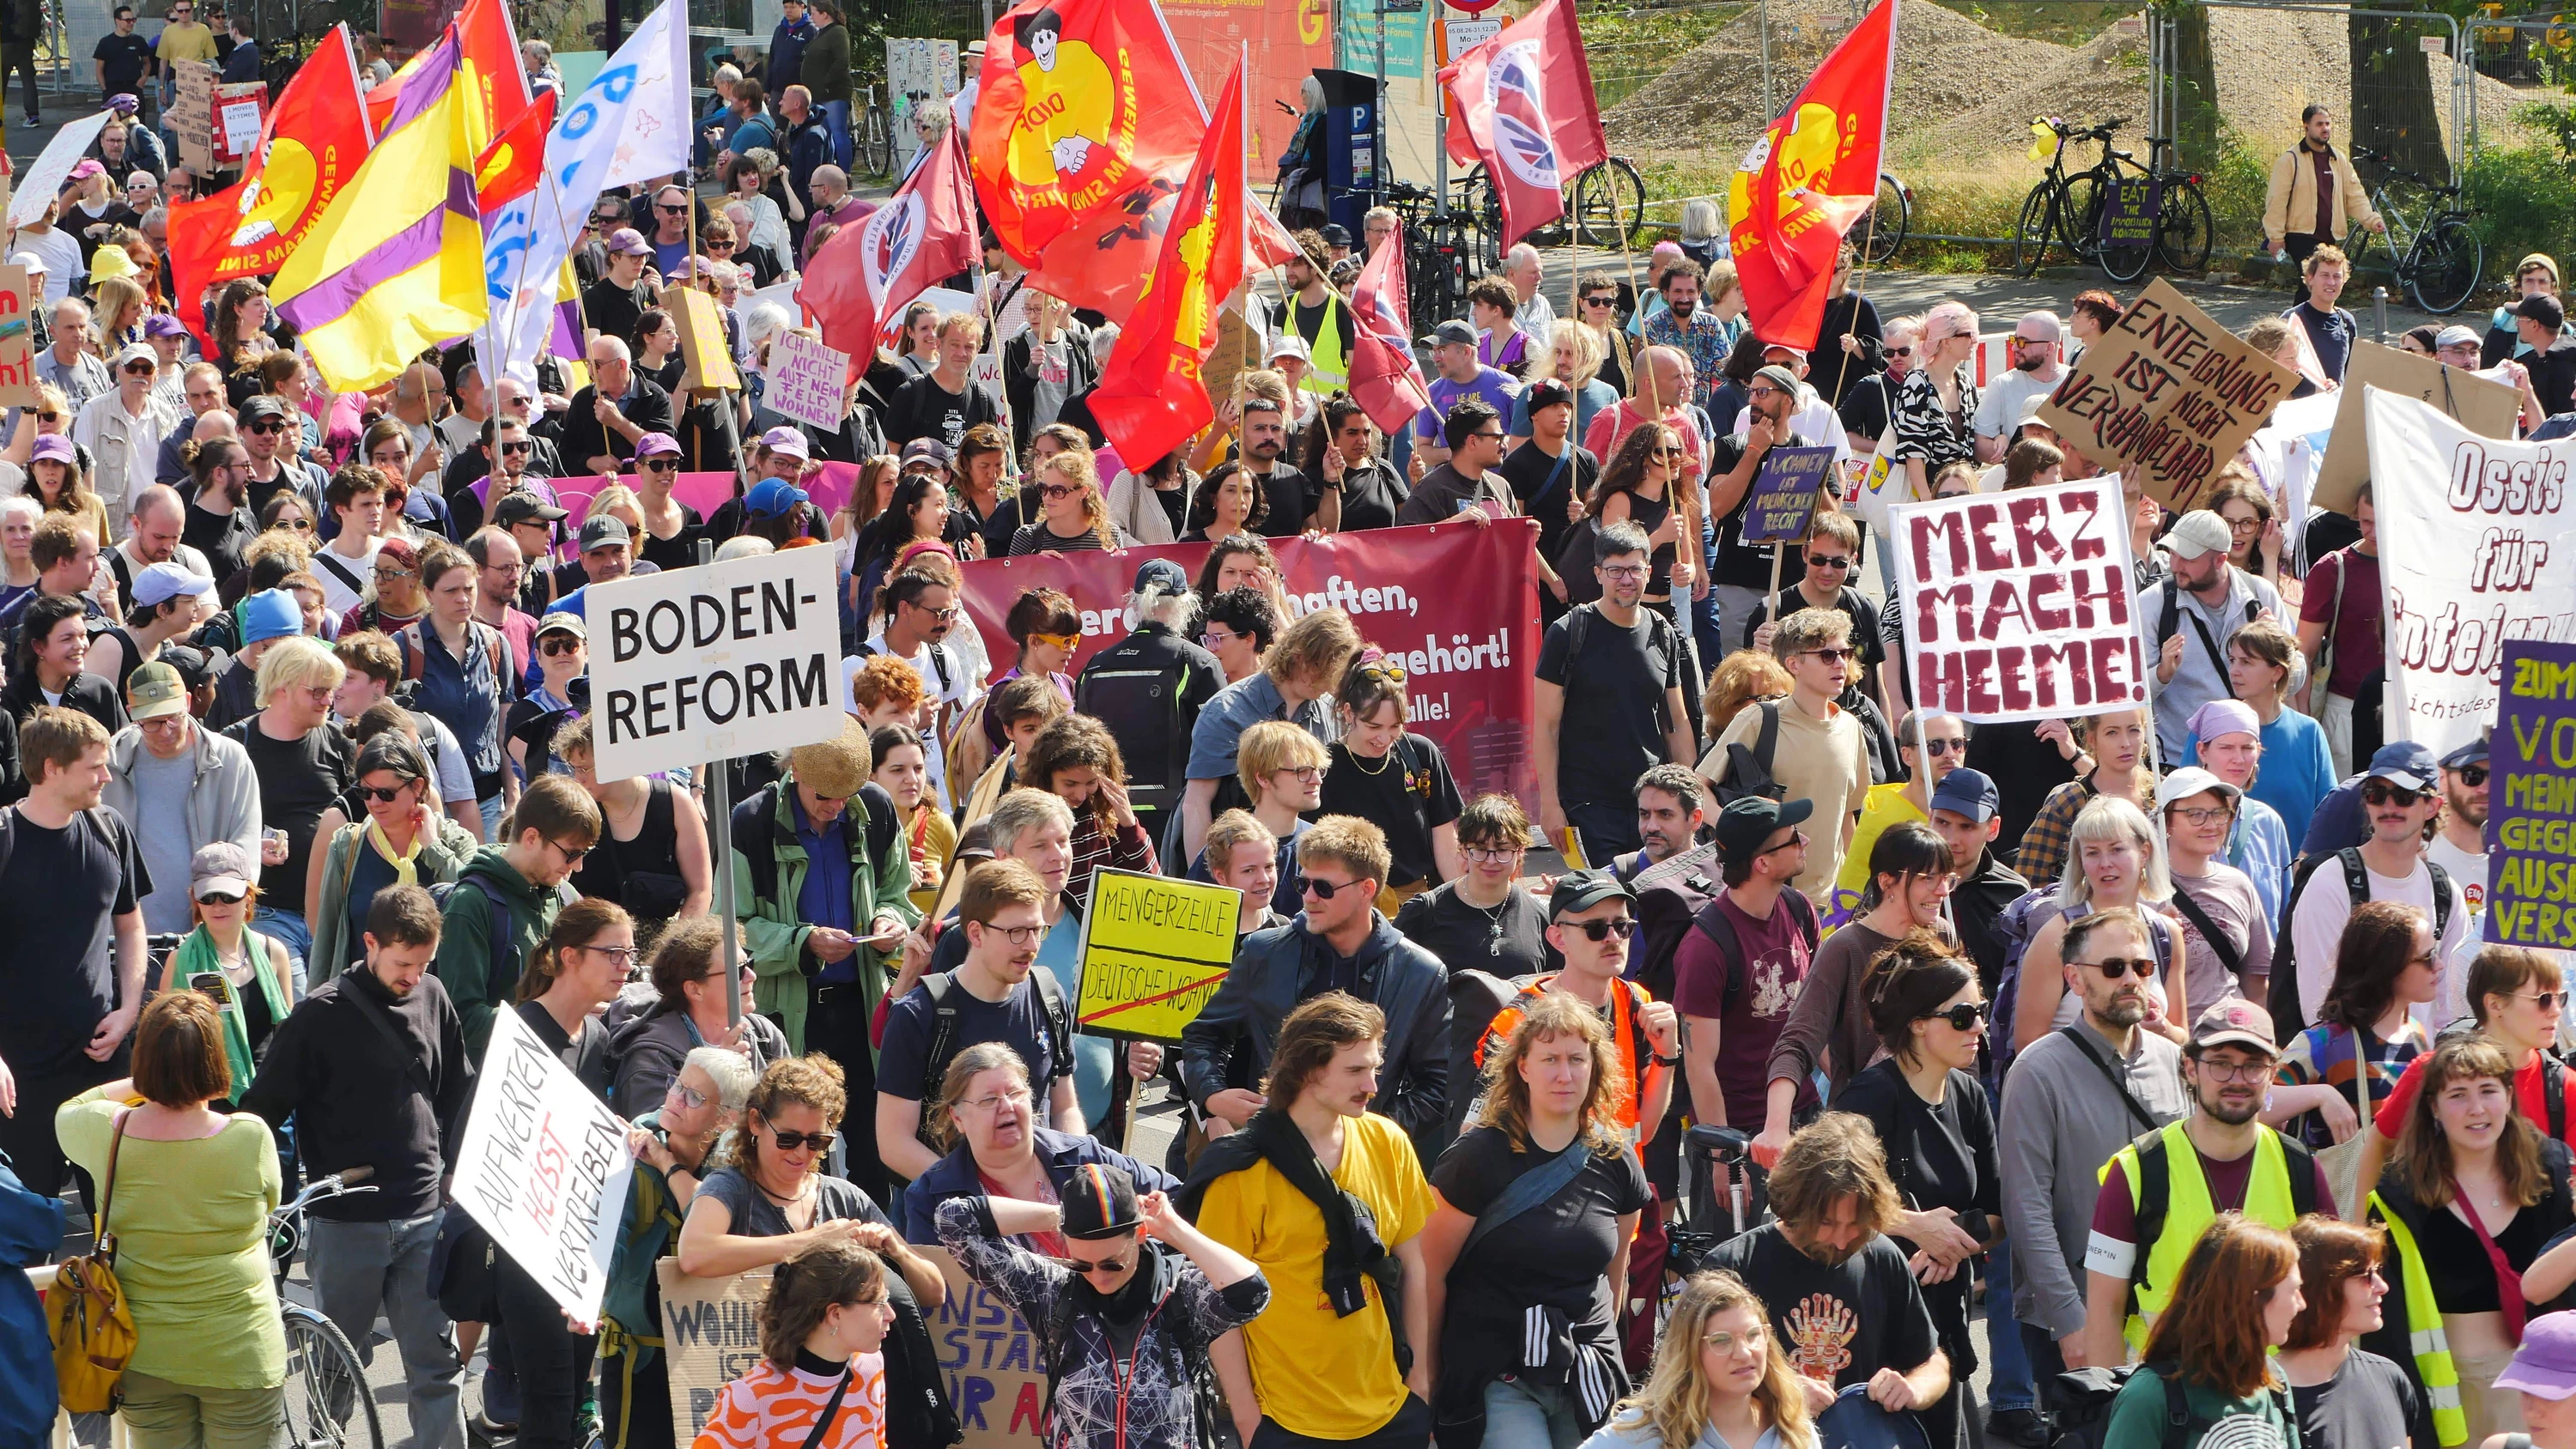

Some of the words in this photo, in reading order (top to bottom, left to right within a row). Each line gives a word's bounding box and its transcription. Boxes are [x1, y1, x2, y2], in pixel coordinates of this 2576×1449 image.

[232, 104, 253, 112] MOVED
[1353, 106, 1365, 128] P
[2120, 185, 2150, 203] EAT
[2123, 205, 2140, 215] THE
[2111, 227, 2152, 239] KONZERNE
[779, 330, 805, 353] ICH
[809, 338, 844, 367] WILL
[2117, 297, 2281, 415] ENTEIGNUNG
[776, 365, 807, 386] AUF
[810, 378, 841, 401] NEM
[790, 355, 837, 380] NICHT
[2112, 350, 2181, 403] IST
[774, 392, 837, 427] WOHNEN
[781, 382, 829, 409] FELD
[1468, 391, 1481, 402] ARE
[2169, 390, 2238, 440] NICHT
[1770, 453, 1828, 475] WOHNEN
[2447, 440, 2567, 515] Ossis
[1777, 476, 1800, 491] IST
[1755, 491, 1820, 512] MENSCHEN
[1762, 512, 1804, 531] RECHT
[1910, 490, 2106, 584] MERZ
[2470, 526, 2549, 592] für
[611, 578, 817, 663] BODEN-
[1917, 565, 2128, 643] MACH
[1917, 635, 2146, 713] HEEME!
[606, 653, 829, 745] REFORM
[2409, 695, 2496, 720] ichtsdes
[1103, 885, 1231, 937] MENGERZEILE
[2465, 888, 2483, 900] EIN
[1085, 963, 1163, 1006] DEUTSCHE
[473, 1022, 550, 1237] AUFWERTEN
